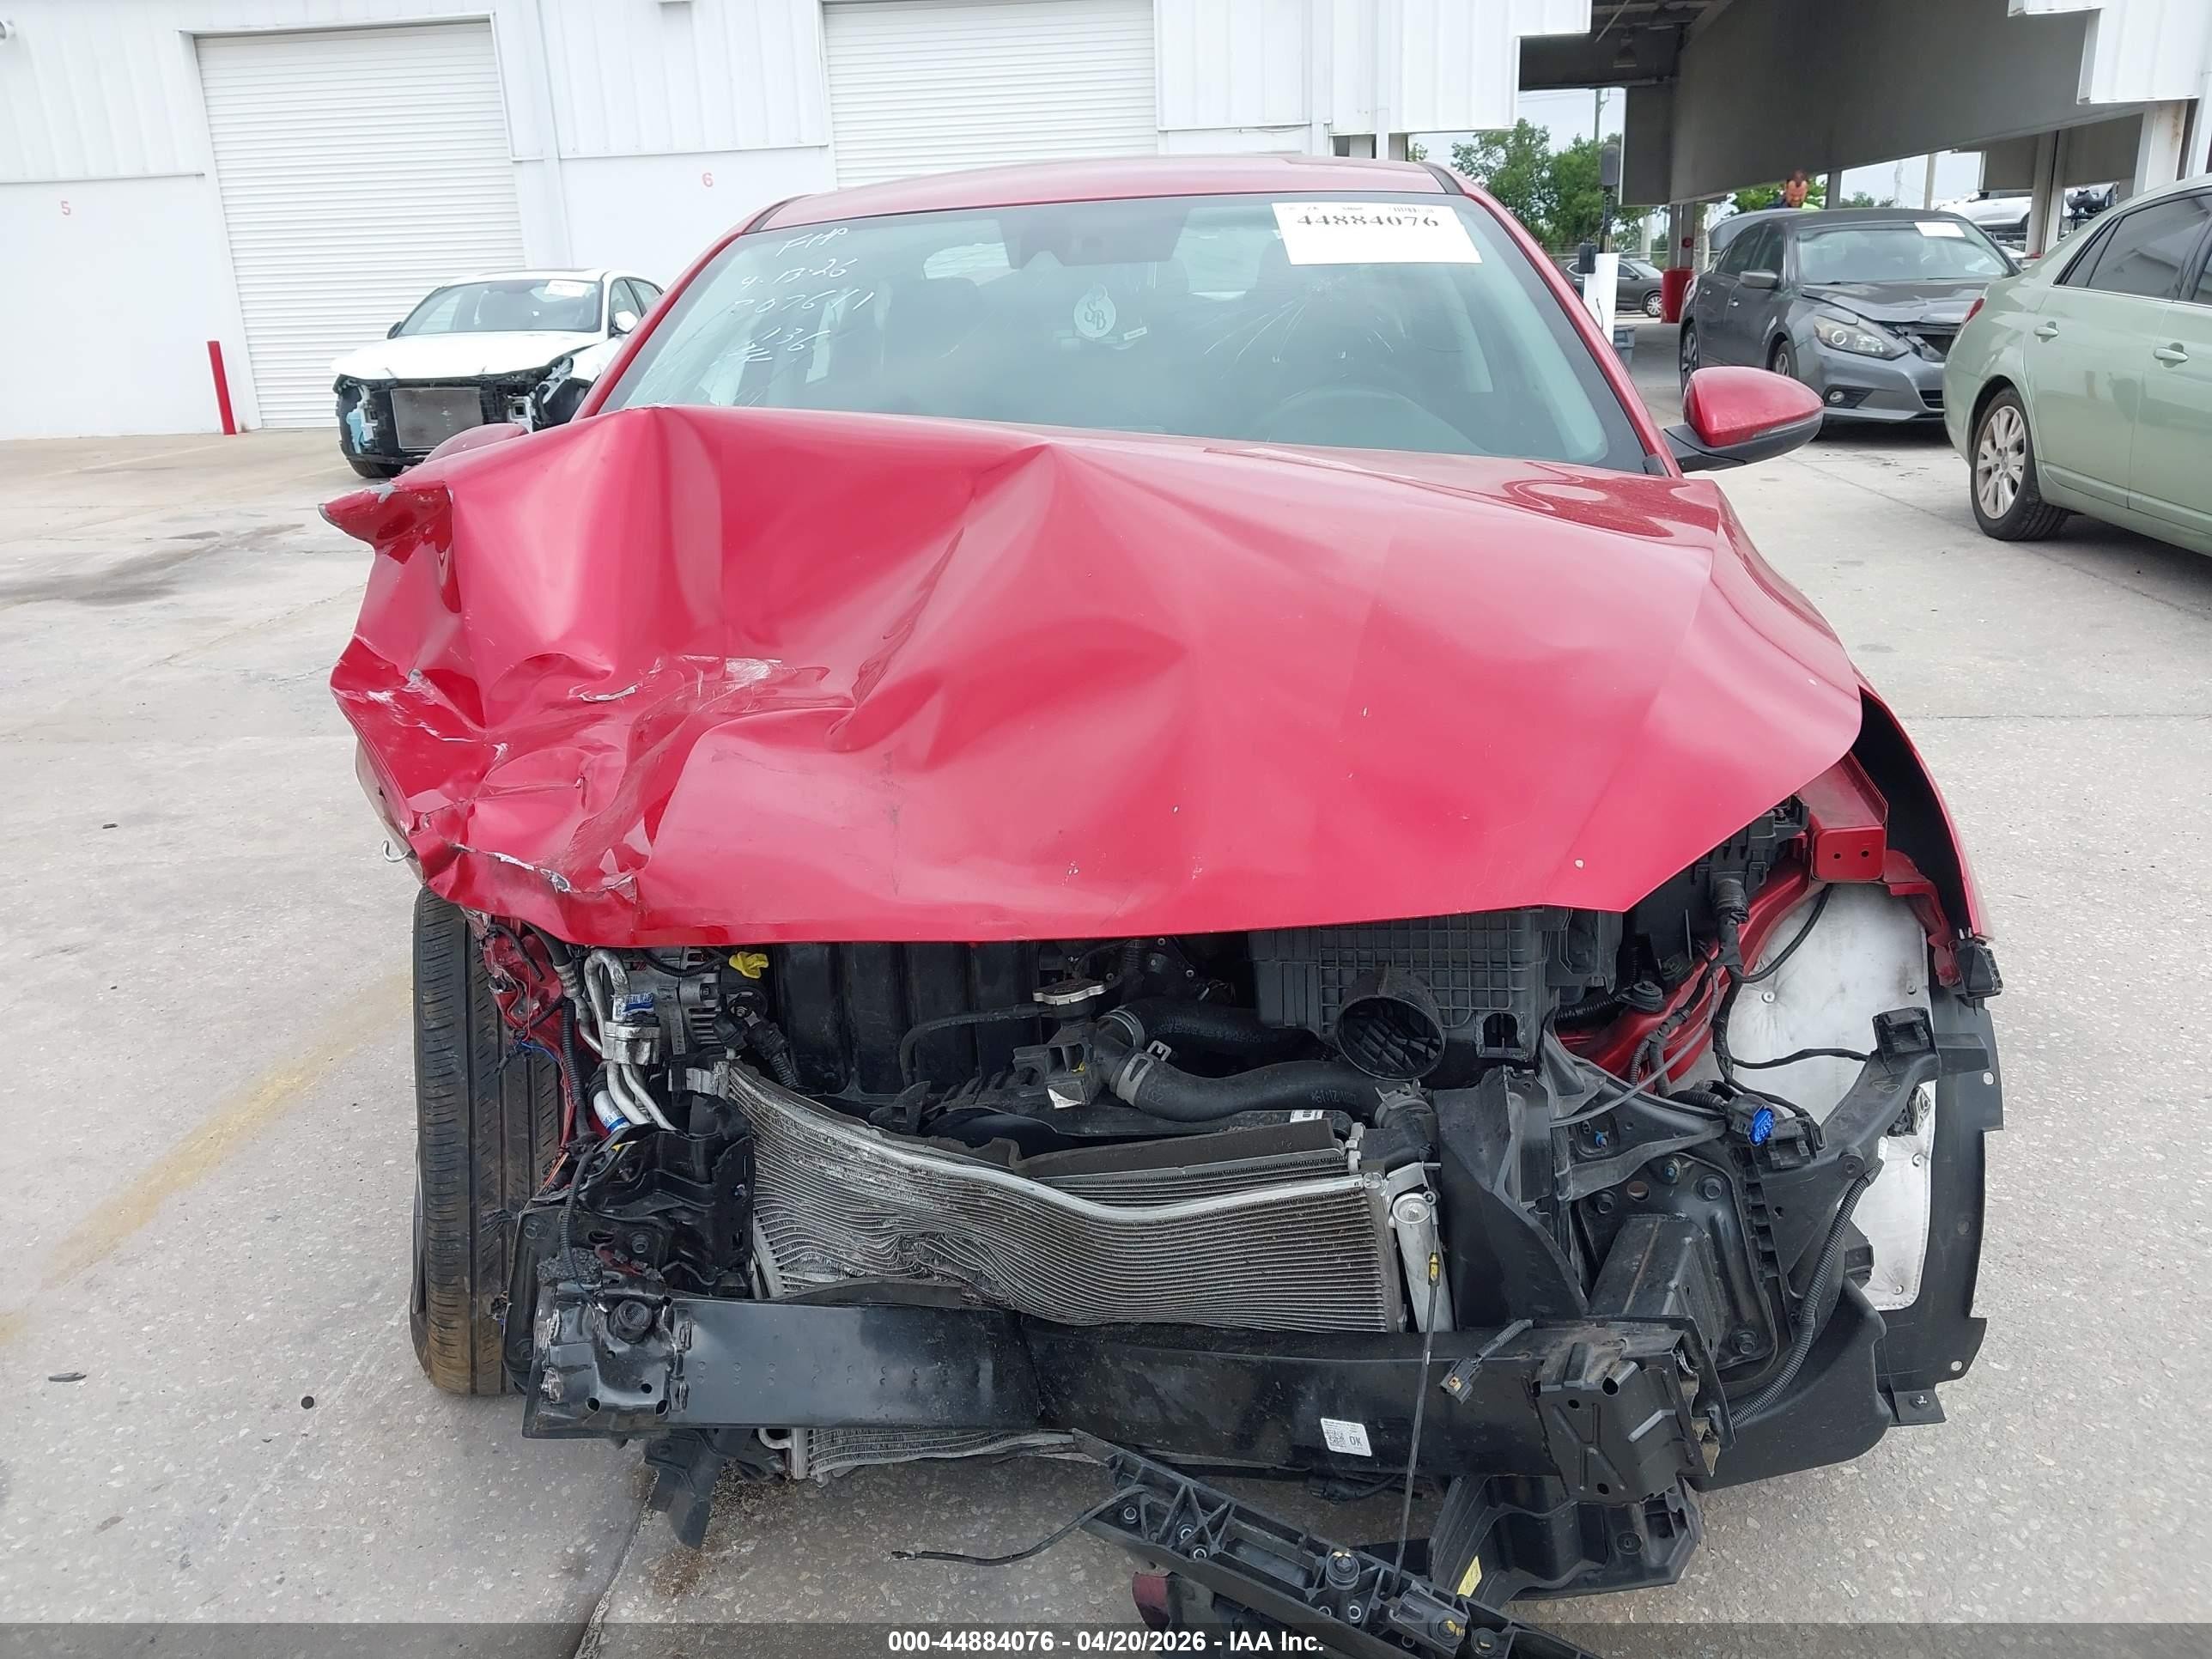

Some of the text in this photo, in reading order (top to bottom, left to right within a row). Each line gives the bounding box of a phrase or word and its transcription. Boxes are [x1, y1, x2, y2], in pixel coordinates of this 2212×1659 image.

[702, 172, 714, 187] 6
[60, 200, 71, 216] 5
[1297, 214, 1439, 227] 44884076
